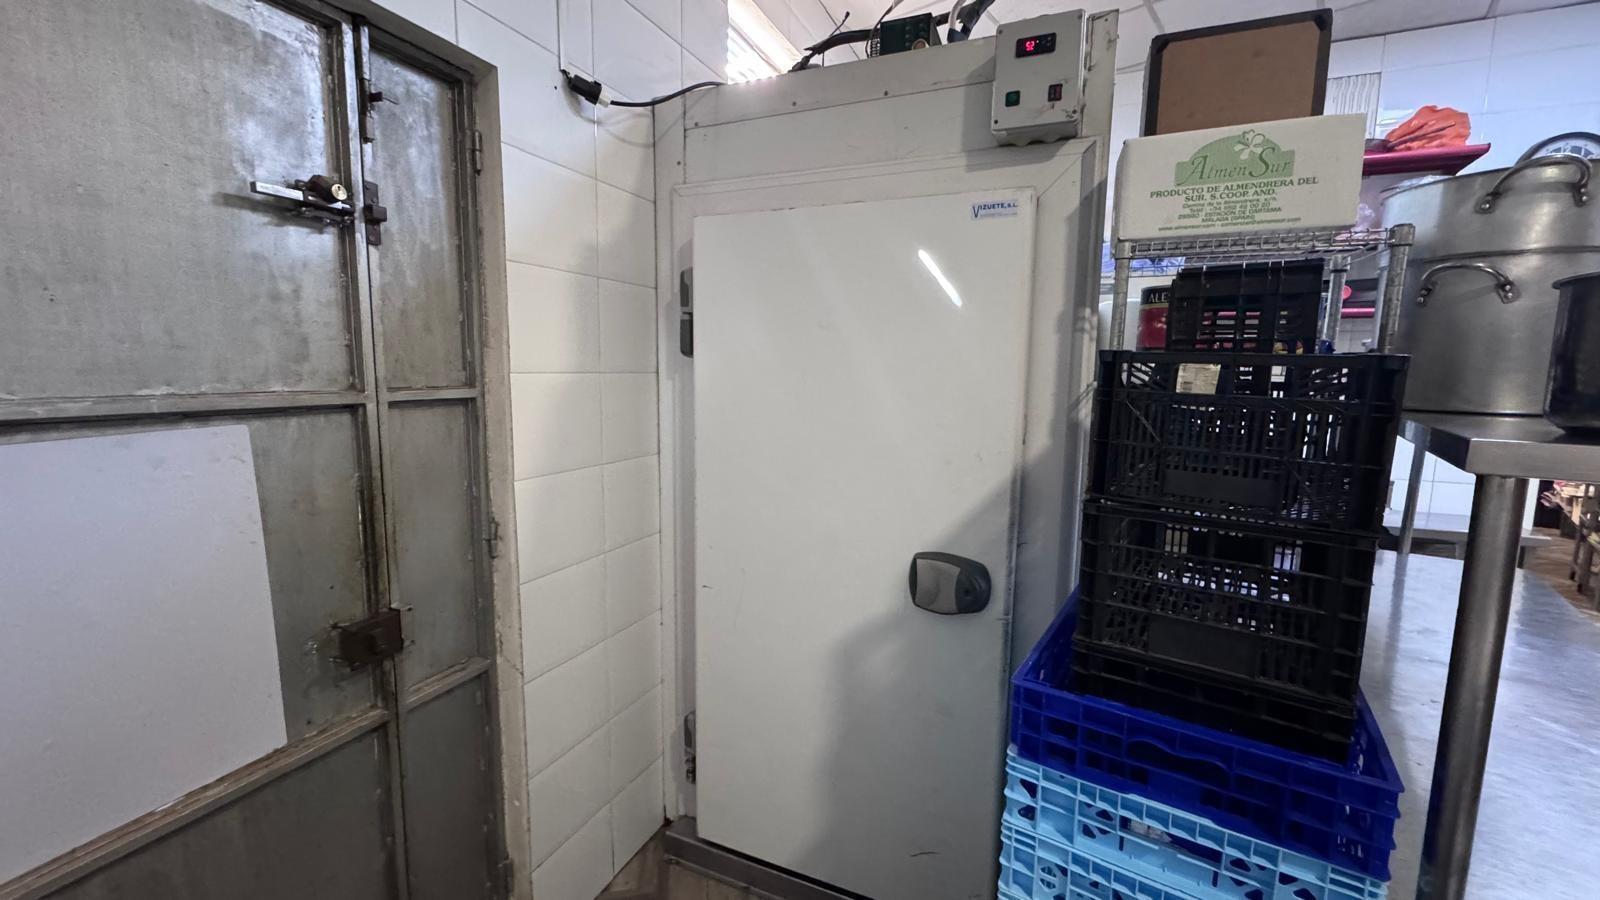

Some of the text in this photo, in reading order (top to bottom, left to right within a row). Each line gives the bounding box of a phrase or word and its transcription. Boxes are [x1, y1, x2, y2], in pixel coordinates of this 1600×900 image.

[1150, 176, 1319, 198] PRODUCTO DE ALMENDRERA DEL
